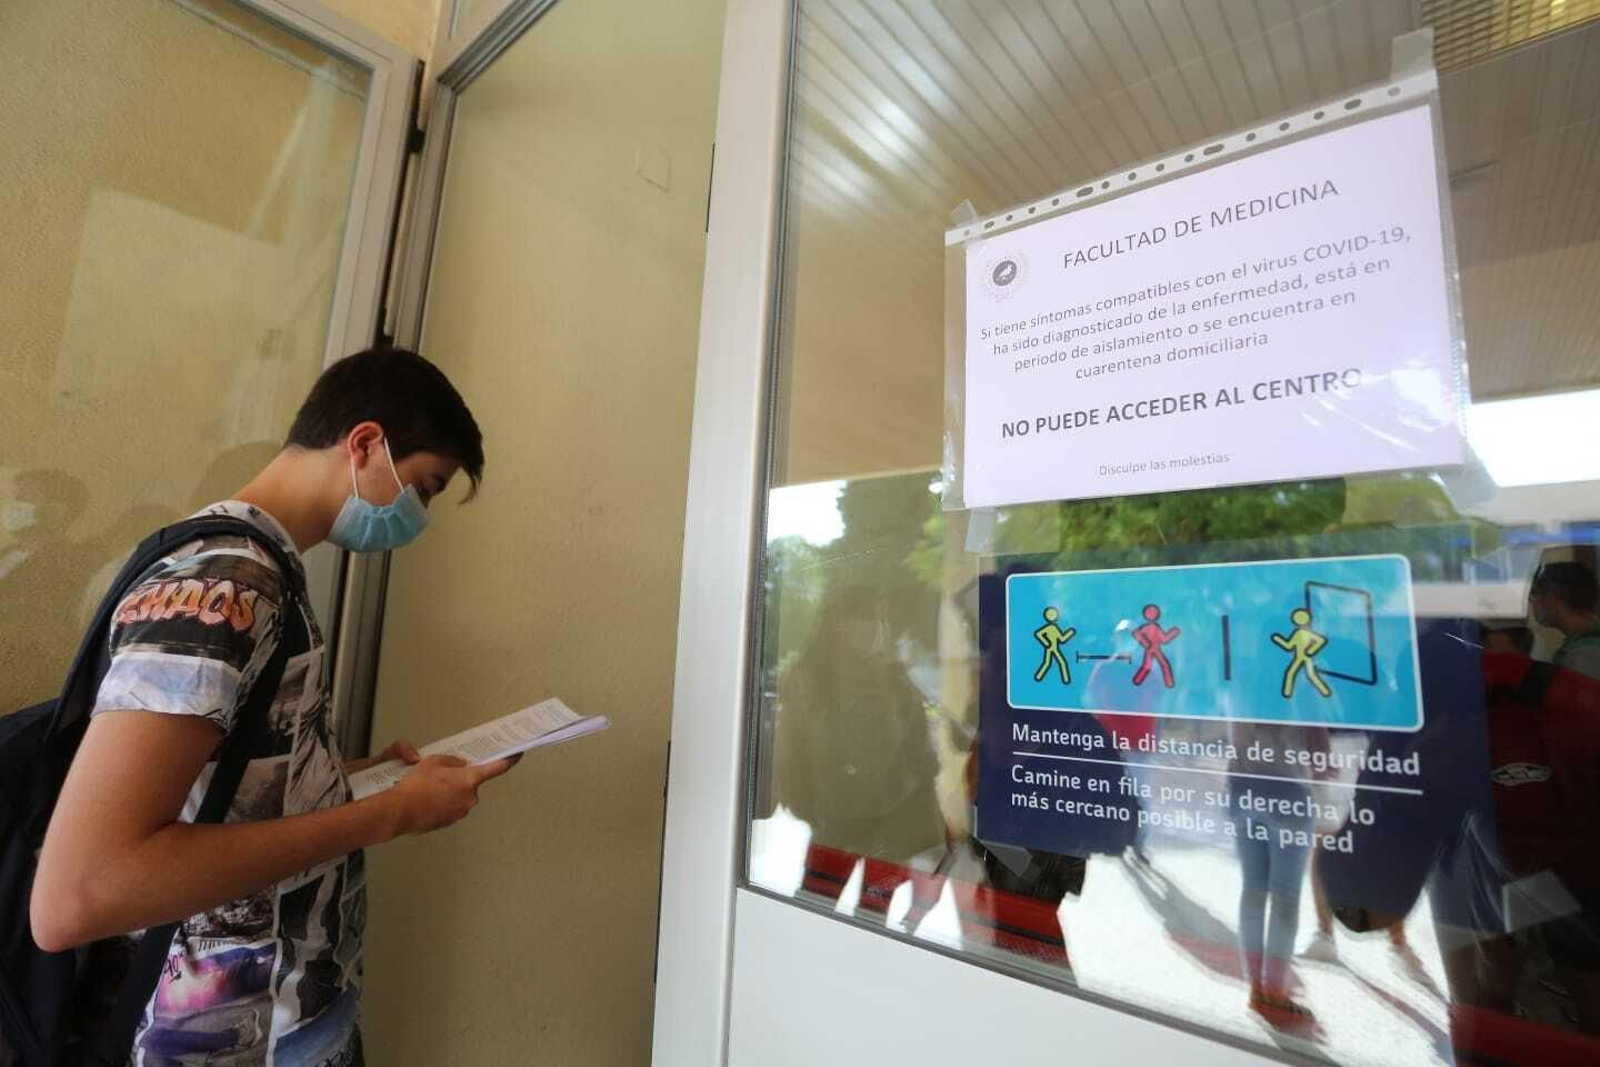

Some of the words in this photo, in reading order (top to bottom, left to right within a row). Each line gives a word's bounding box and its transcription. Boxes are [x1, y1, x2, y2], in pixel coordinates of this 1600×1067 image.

[1064, 226, 1166, 268] FACULTAD
[1175, 216, 1202, 238] DE
[1211, 180, 1338, 228] MEDICINA
[981, 326, 991, 340] Si
[995, 321, 1027, 336] tiene
[1030, 303, 1092, 328] síntomas
[1096, 280, 1190, 312] compatibles
[1196, 271, 1226, 288] con
[1232, 262, 1247, 280] el
[1253, 254, 1298, 275] virus
[1303, 226, 1411, 263] COVID-19,
[993, 342, 1008, 355] ha
[1012, 334, 1039, 352] sido
[1042, 311, 1143, 345] diagnosticado
[1148, 306, 1167, 321] de
[1173, 302, 1186, 316] la
[1191, 274, 1309, 311] enfermedad,
[1315, 263, 1357, 285] está
[1364, 258, 1390, 275] en
[1014, 349, 1067, 372] periodo
[1071, 345, 1088, 359] de
[1093, 325, 1183, 354] aislamiento
[1188, 323, 1199, 335] o
[1203, 318, 1222, 332] se
[1228, 297, 1324, 328] encuentra
[1331, 291, 1356, 307] en
[1075, 352, 1161, 379] cuarentena
[1167, 333, 1269, 363] domiciliaria
[1001, 419, 1030, 438] NO
[1036, 408, 1100, 434] PUEDE
[1105, 391, 1208, 423] ACCEDER
[1214, 385, 1246, 406] AL
[1252, 367, 1363, 401] CENTRO
[1099, 461, 1147, 476] Disculpe
[1149, 459, 1166, 472] las
[1169, 453, 1230, 469] molestias
[1012, 723, 1104, 750] Mantenga
[1112, 731, 1130, 751] la
[1138, 733, 1238, 760] distancia
[1246, 741, 1275, 763] de
[1284, 750, 1420, 776] seguridad
[1011, 764, 1081, 790] Camine
[1087, 777, 1110, 794] en
[1119, 775, 1152, 798] fila
[1160, 786, 1195, 806] por
[1204, 791, 1231, 808] su
[1238, 789, 1339, 822] derecha
[1349, 802, 1376, 826] lo
[1011, 790, 1049, 811] más
[1055, 797, 1130, 822] cercano
[1137, 808, 1216, 834] posible
[1223, 820, 1237, 837] a
[1246, 819, 1269, 842] la
[1279, 827, 1354, 854] pared
